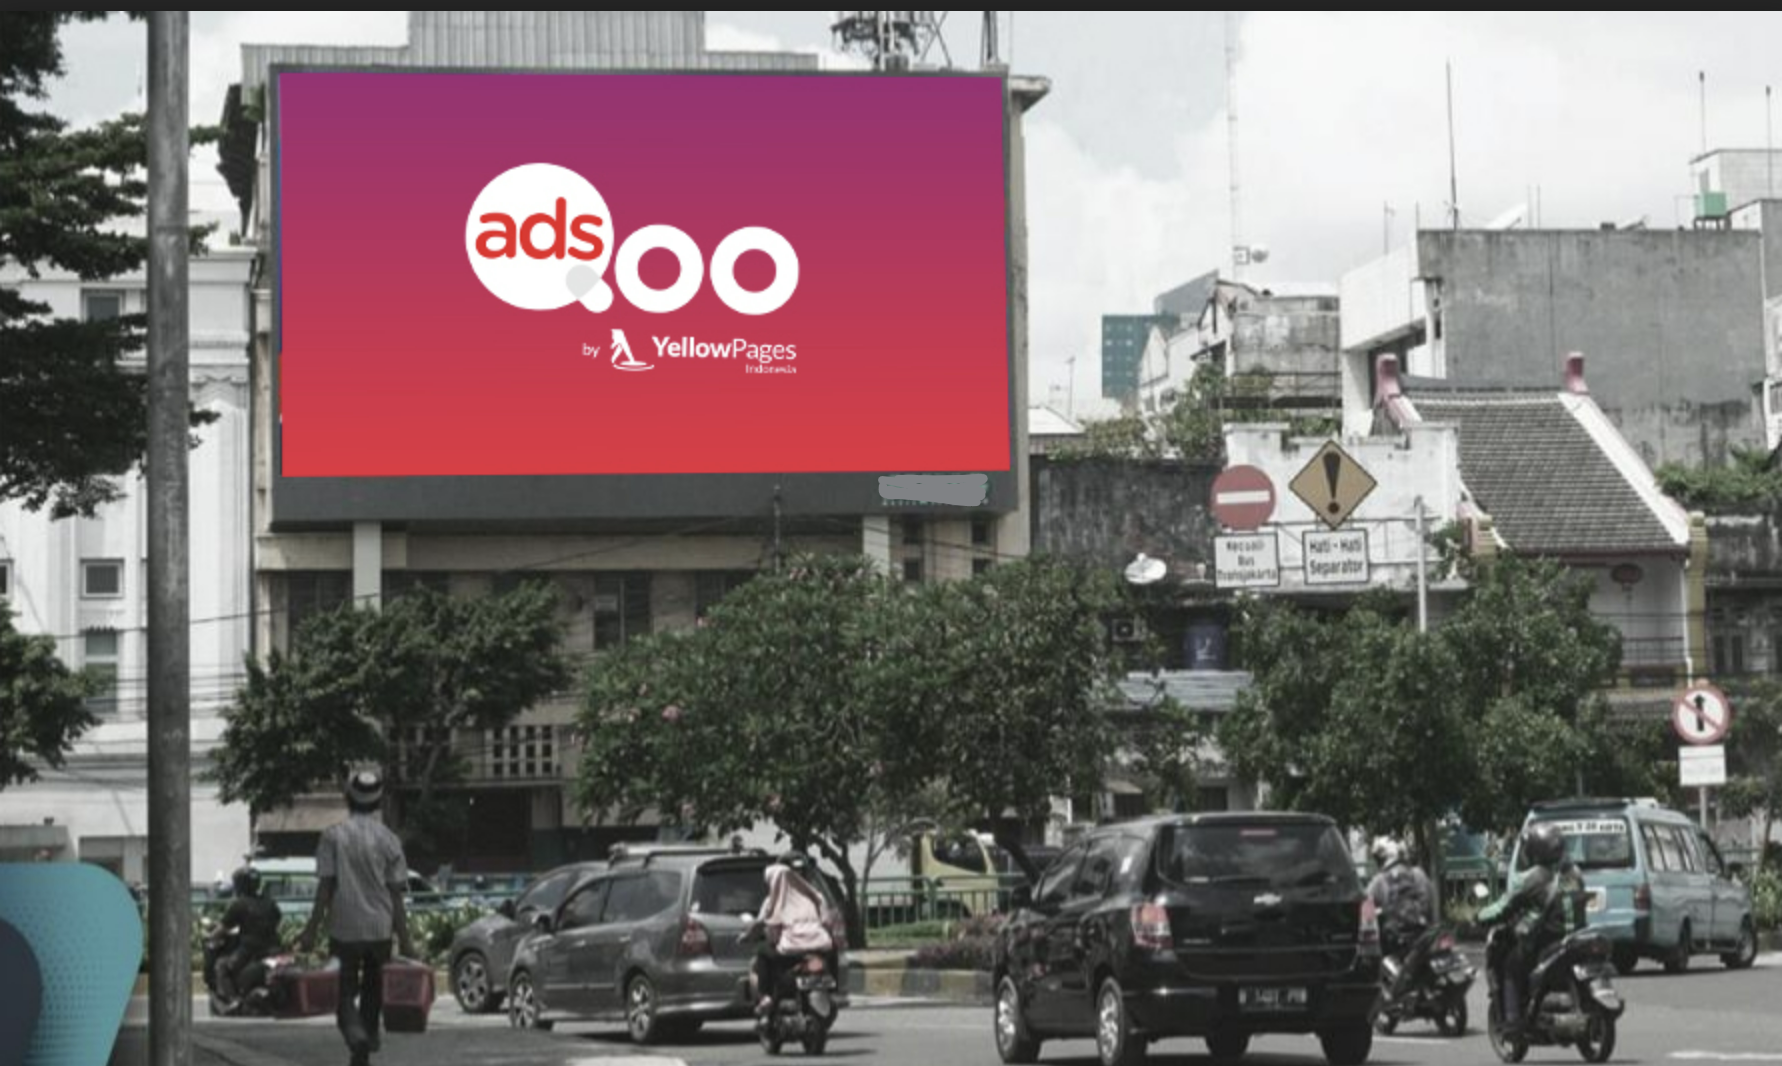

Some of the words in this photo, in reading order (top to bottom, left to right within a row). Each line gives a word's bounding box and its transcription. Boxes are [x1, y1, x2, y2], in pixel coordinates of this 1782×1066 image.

[474, 196, 605, 261] ads
[582, 343, 601, 358] by
[651, 336, 798, 364] YellowPages
[745, 364, 798, 375] Indonesia
[1309, 539, 1330, 553] Hati
[1341, 538, 1362, 553] Hati
[1237, 555, 1255, 567] Bus
[1309, 559, 1364, 577] Separator
